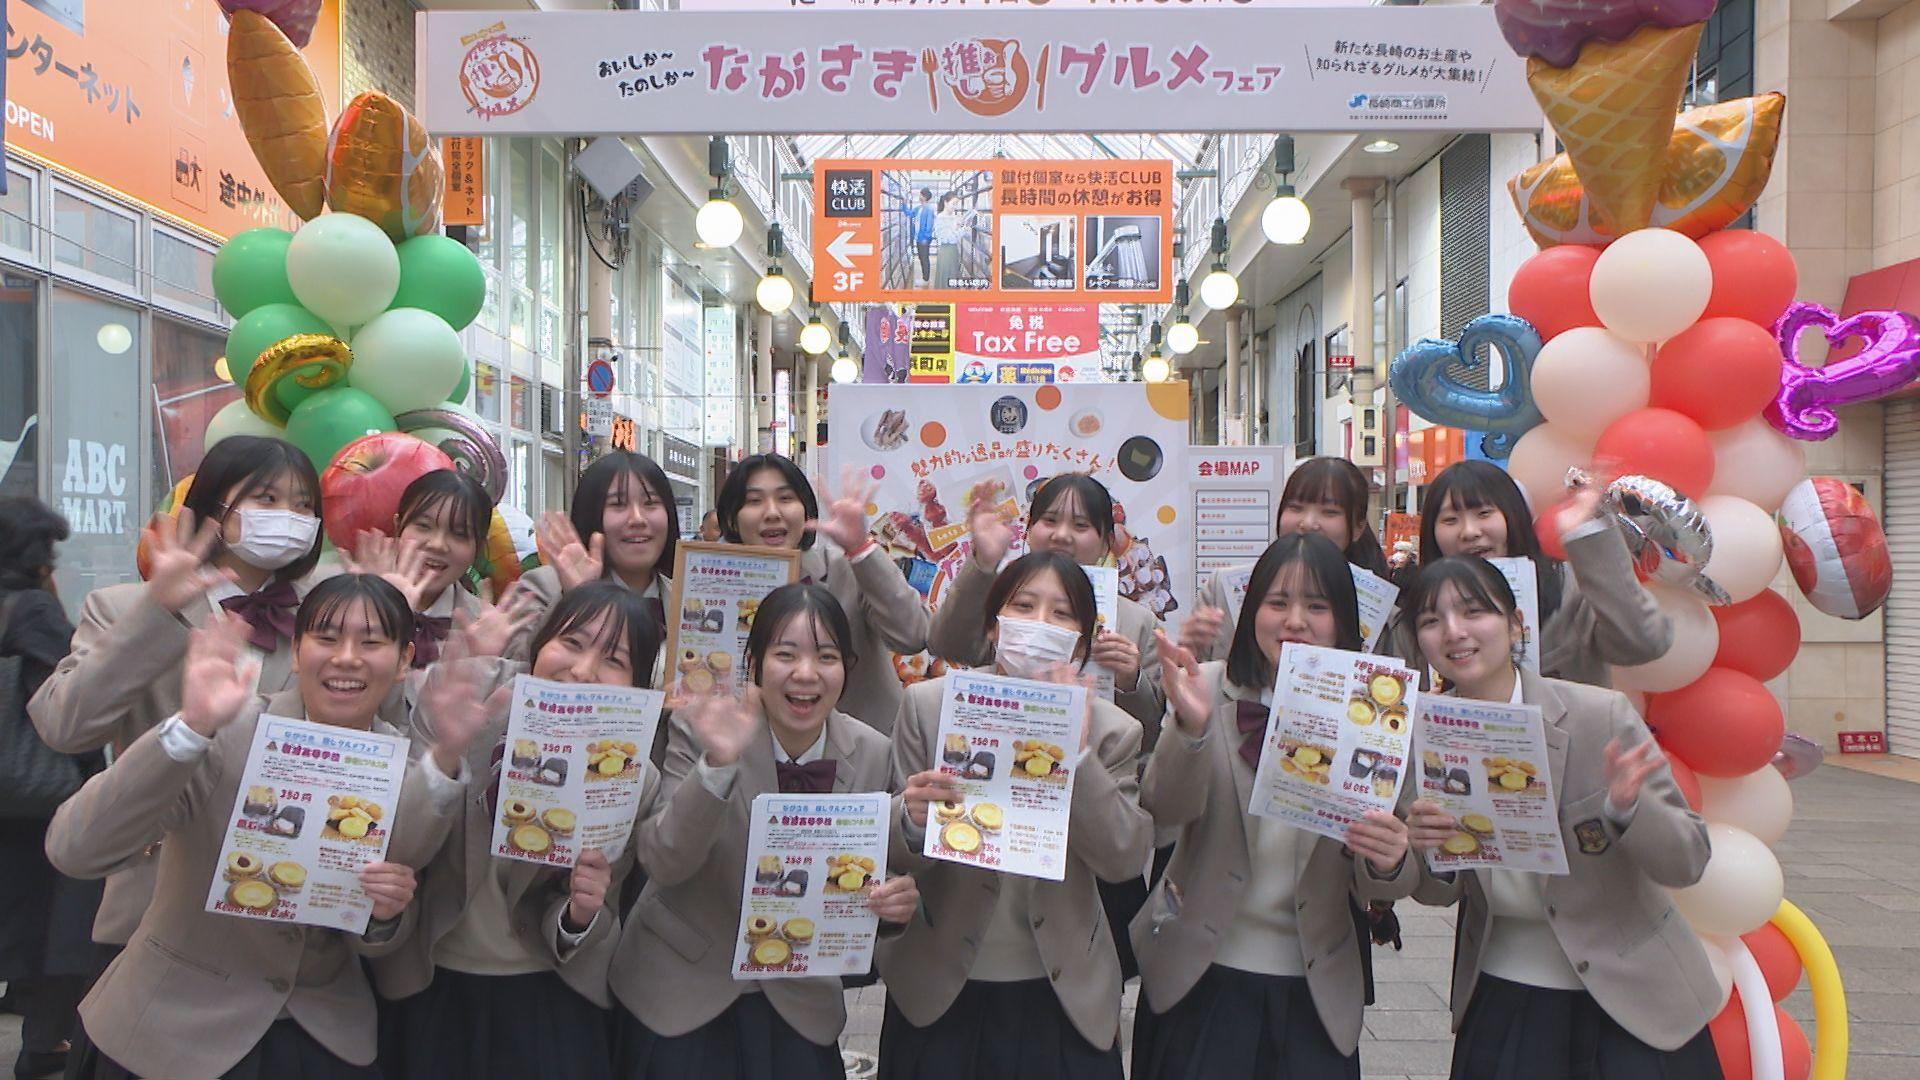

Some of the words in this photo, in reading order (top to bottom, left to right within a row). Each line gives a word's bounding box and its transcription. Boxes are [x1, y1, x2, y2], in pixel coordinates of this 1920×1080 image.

[1334, 40, 1472, 64] 新たな長崎のお土産や
[703, 44, 917, 98] ながさき
[5, 99, 55, 142] OPEN
[831, 179, 866, 196] 快活
[1001, 169, 1162, 186] 鍵付個室なら快活CLUB
[831, 197, 866, 211] CLUB
[1001, 189, 1162, 207] 長時間の休憩がお得
[832, 271, 865, 292] 3F
[1009, 315, 1045, 331] 免税
[972, 331, 1017, 353] Tax
[1024, 331, 1081, 353] Free
[62, 438, 127, 496] ABC
[1197, 460, 1260, 477] 会場MAP
[62, 497, 127, 535] MART
